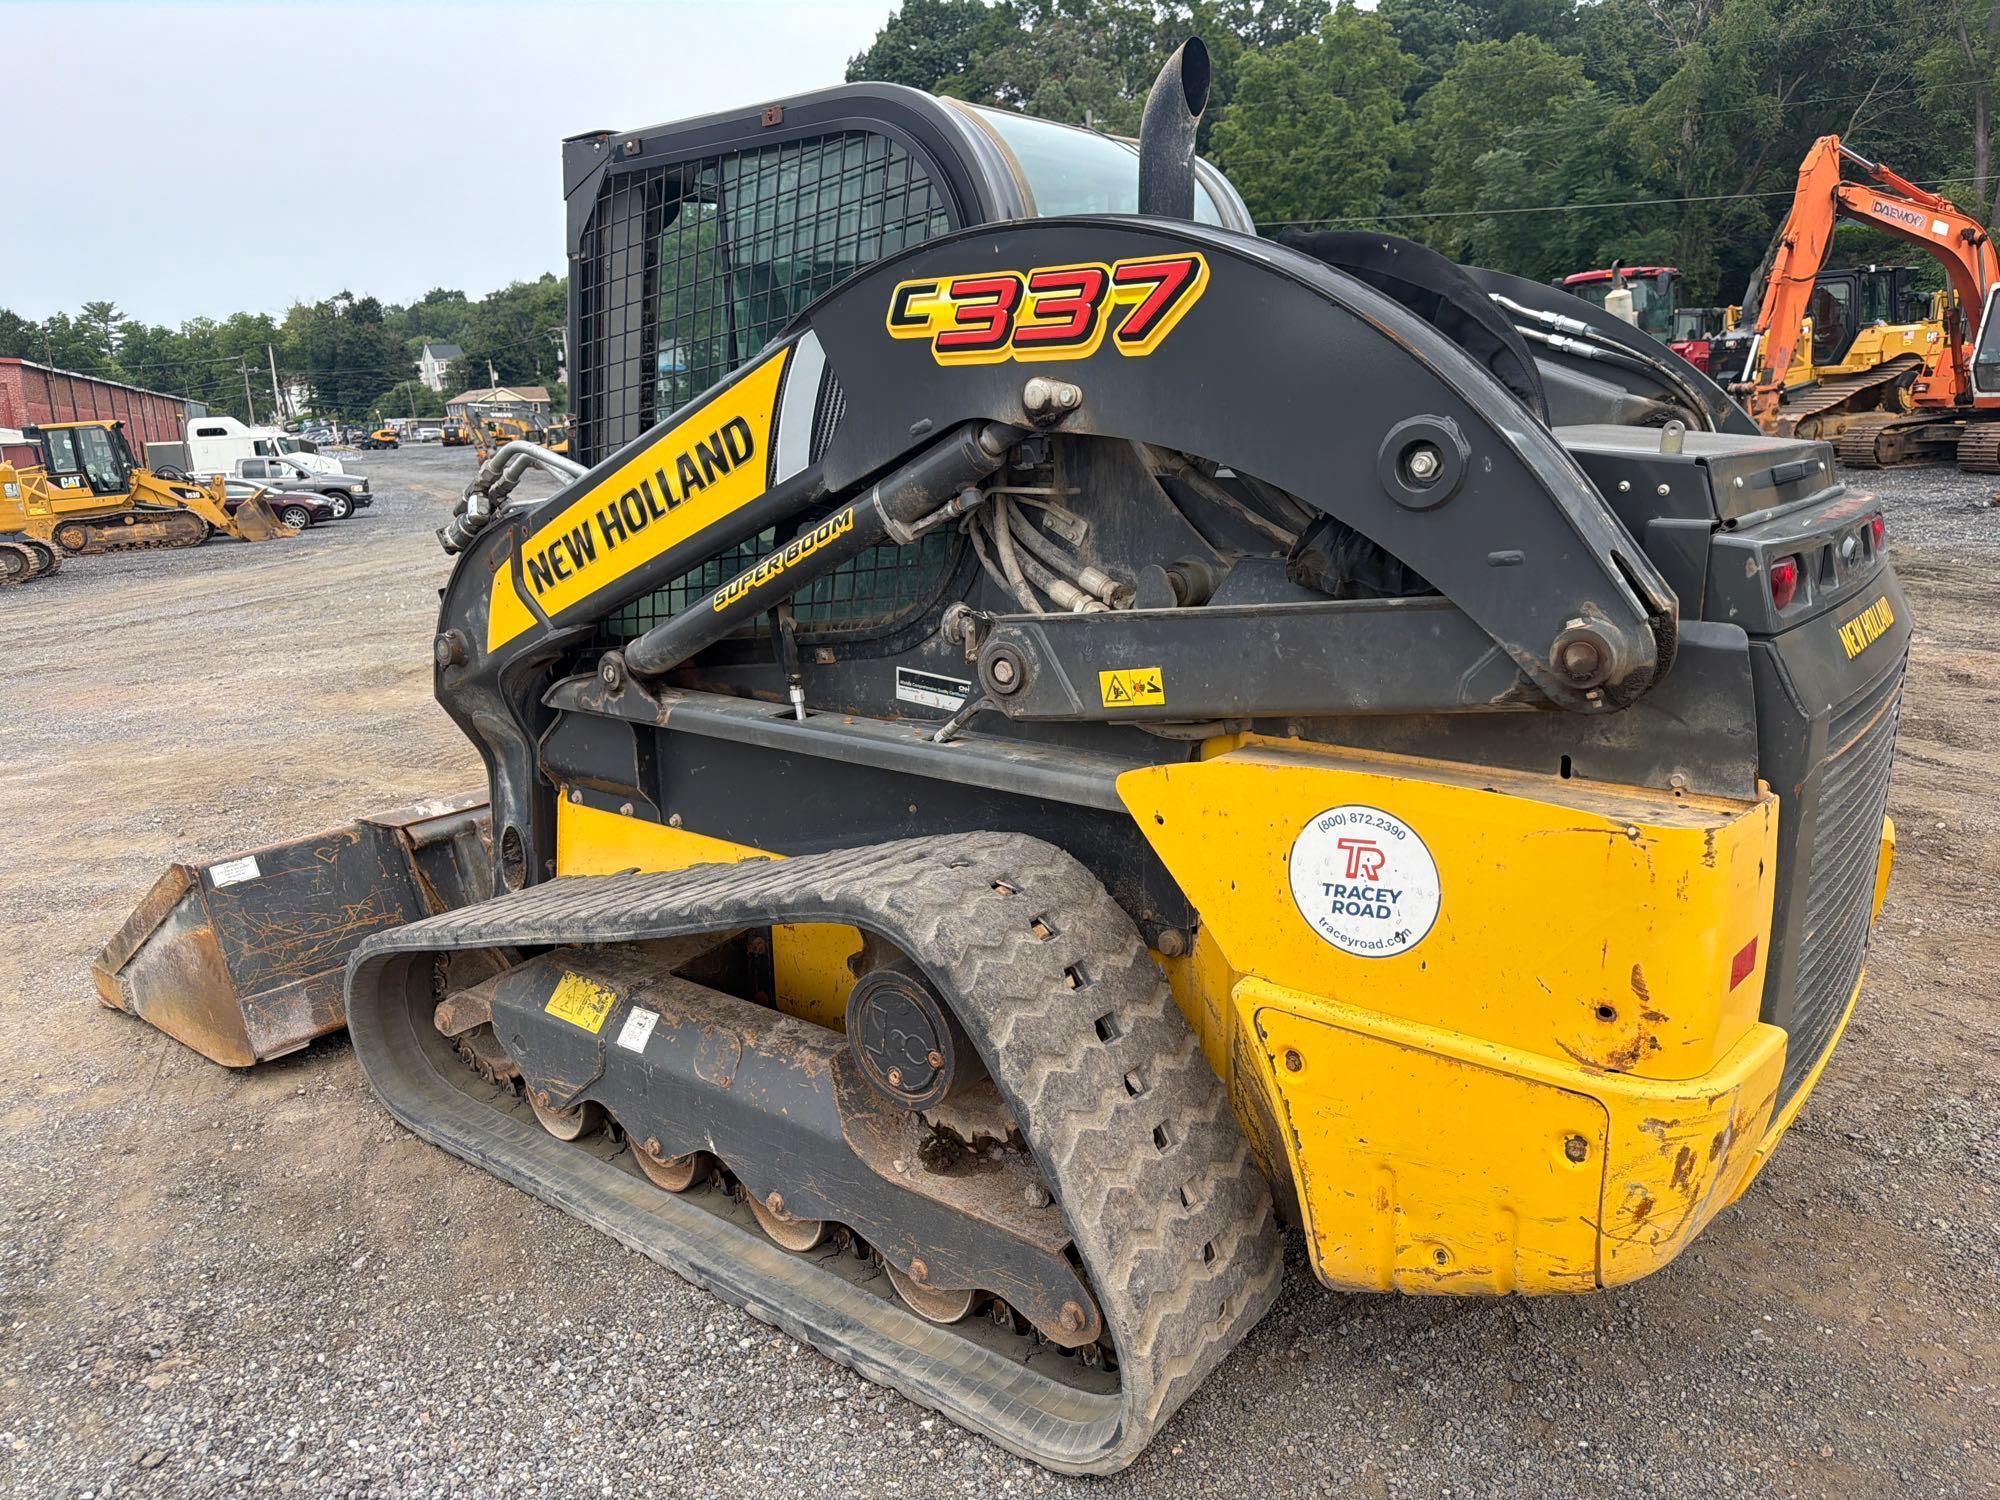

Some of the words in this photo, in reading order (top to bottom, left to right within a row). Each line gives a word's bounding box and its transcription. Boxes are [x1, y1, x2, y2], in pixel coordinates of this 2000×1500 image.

[887, 252, 1210, 366] C337
[60, 476, 81, 489] CAT
[527, 521, 599, 597] NEW
[596, 415, 757, 552] HOLLAND
[713, 552, 784, 613] SUPER
[785, 507, 854, 568] BOOM
[1837, 617, 1868, 660] NEW
[1859, 595, 1895, 644] HOLLAND
[1317, 813, 1347, 833] (800)
[1349, 812, 1406, 841] 872.2390
[1323, 882, 1403, 904] TRACEY
[1331, 900, 1392, 920] ROAD
[1318, 916, 1412, 950] traceyroad.com
